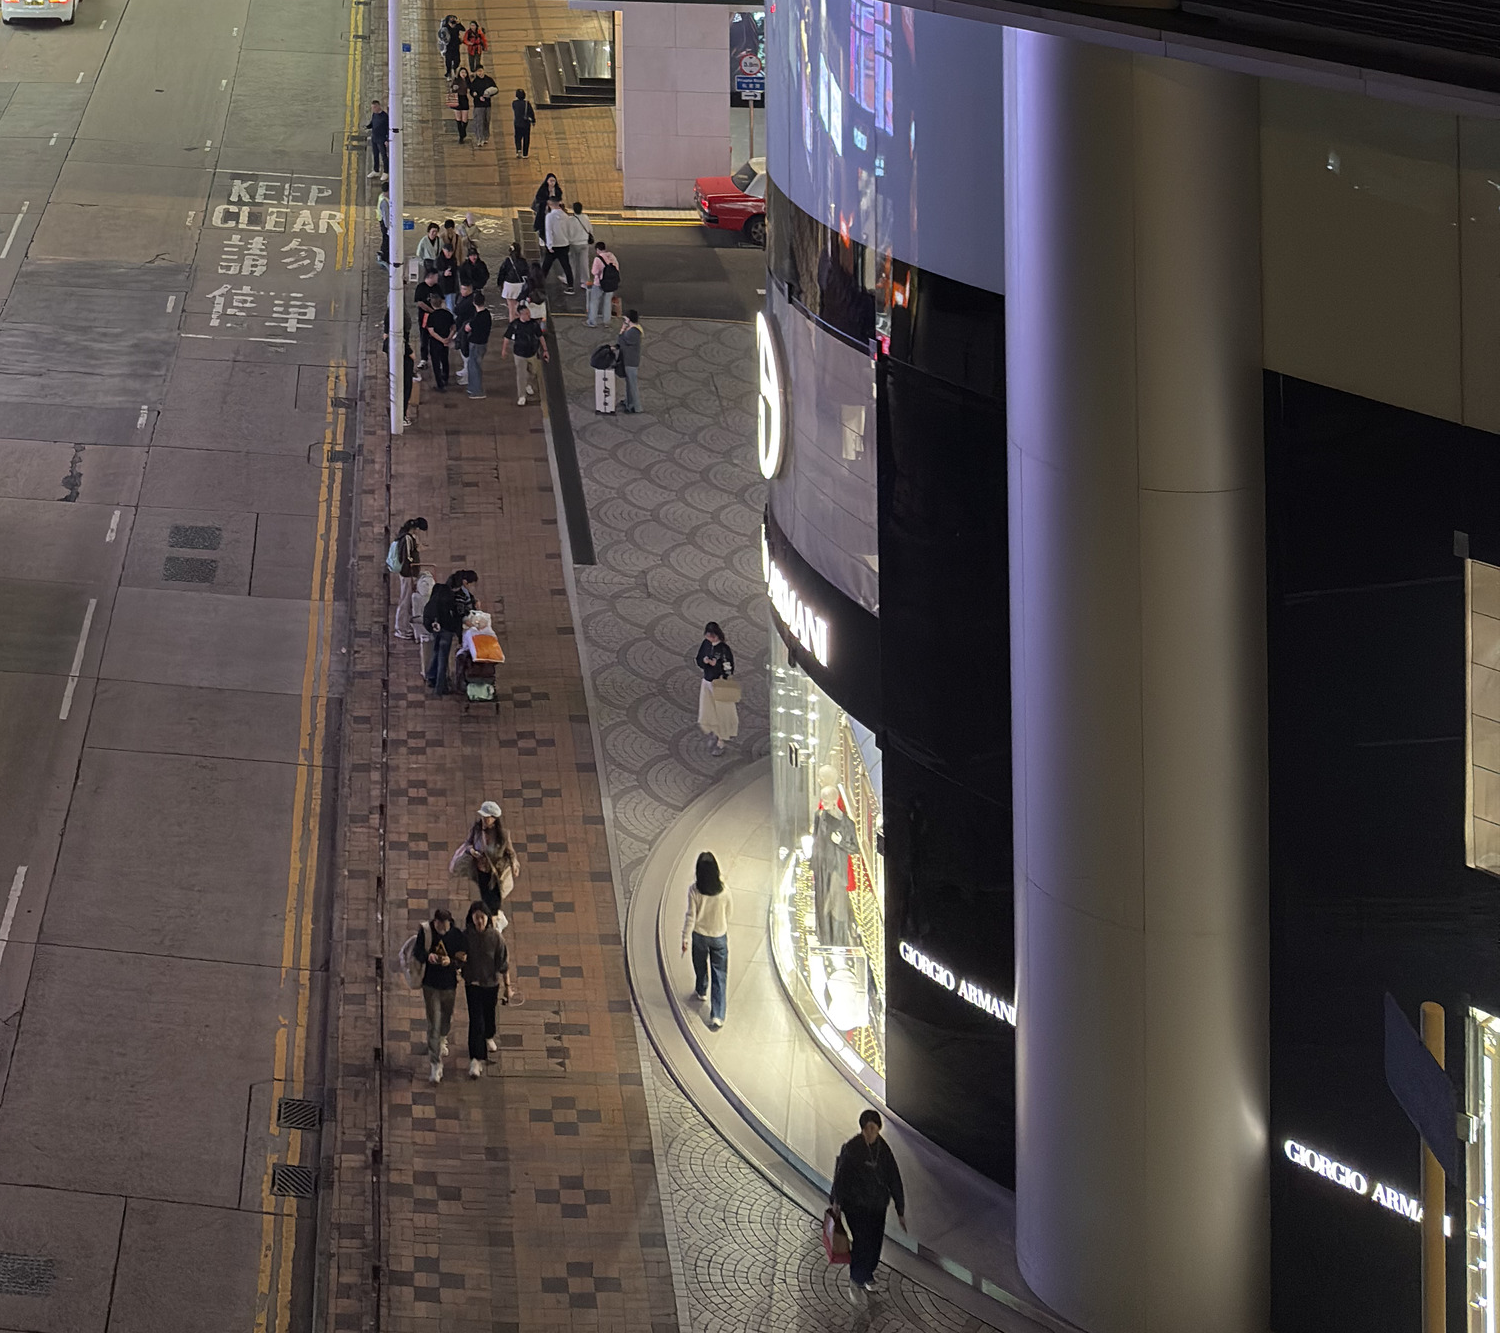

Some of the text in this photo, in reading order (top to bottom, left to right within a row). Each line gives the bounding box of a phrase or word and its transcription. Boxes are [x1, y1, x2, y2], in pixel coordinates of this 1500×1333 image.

[228, 179, 332, 206] KEEP
[211, 204, 346, 234] CLEAR
[217, 234, 327, 279] 請勿
[898, 940, 1017, 1027] GIORGIO ARMANI
[1283, 1139, 1368, 1195] GIORGIO
